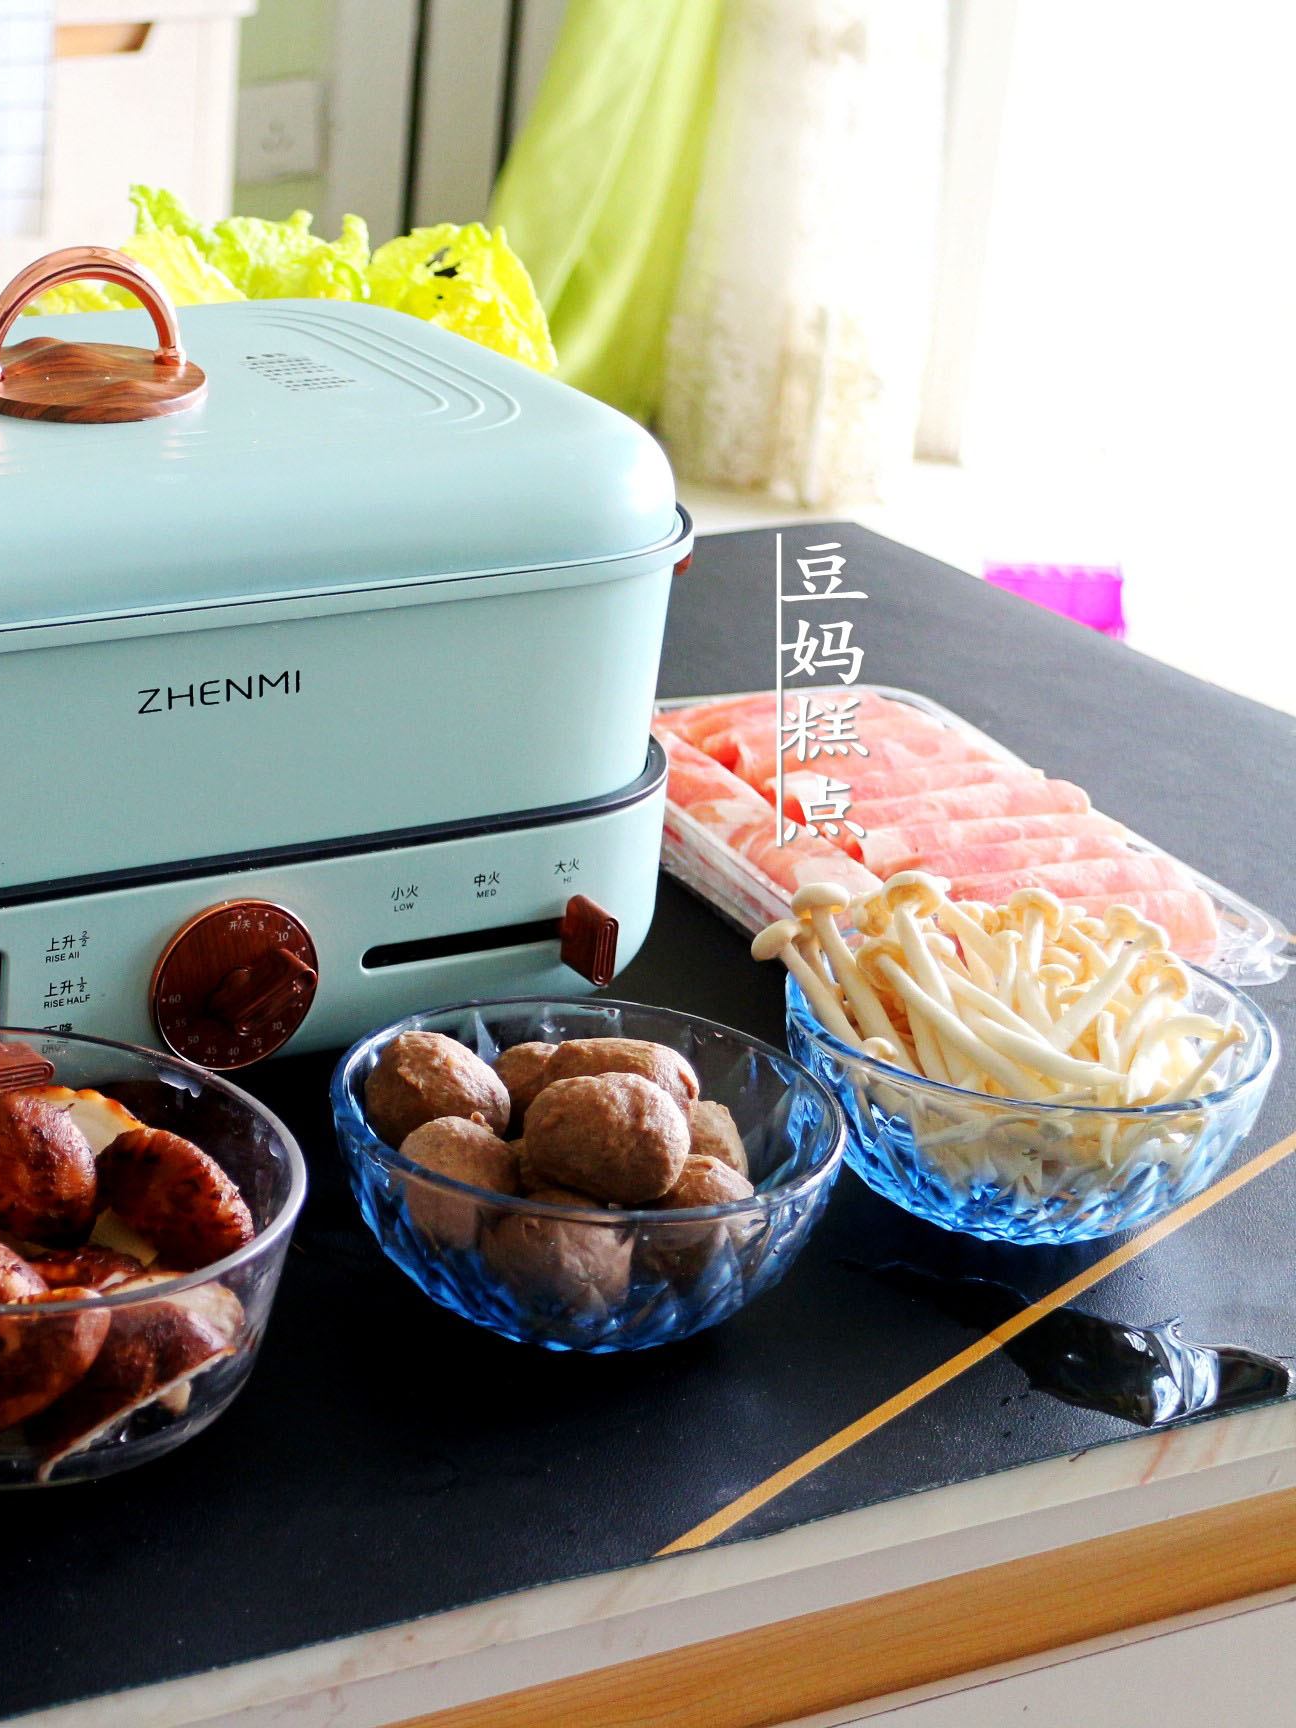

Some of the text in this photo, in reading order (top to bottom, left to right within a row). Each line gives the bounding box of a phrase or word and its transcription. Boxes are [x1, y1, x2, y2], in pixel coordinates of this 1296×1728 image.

[138, 669, 300, 714] ZHENMI
[554, 858, 580, 874] 大火
[473, 871, 500, 887] 中火
[391, 884, 419, 901] 小火
[476, 889, 497, 899] MED
[393, 902, 414, 912] LOW
[278, 932, 289, 942] 10
[45, 954, 66, 964] RISE
[44, 994, 91, 1009] RISE HALF
